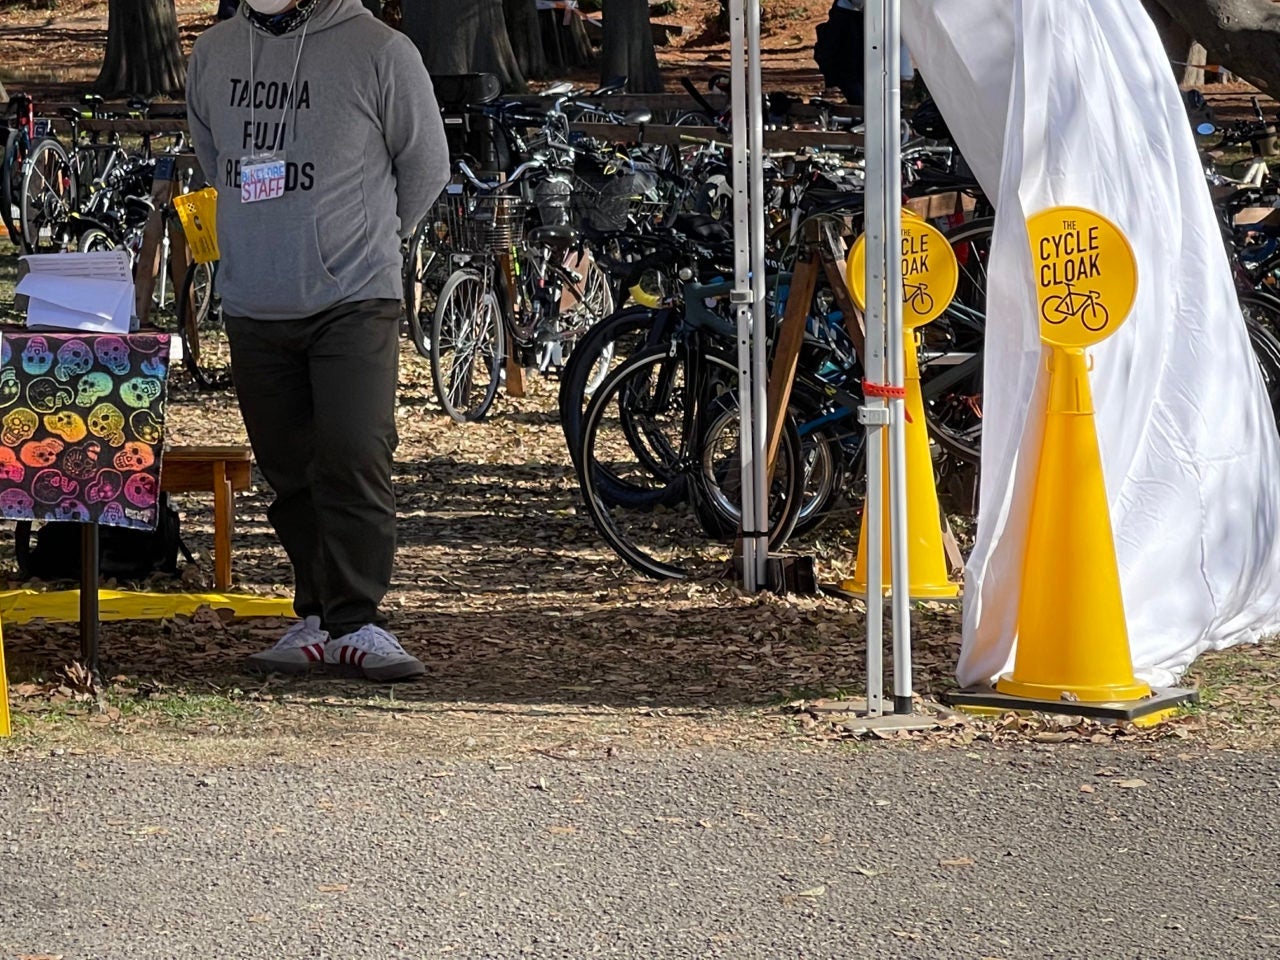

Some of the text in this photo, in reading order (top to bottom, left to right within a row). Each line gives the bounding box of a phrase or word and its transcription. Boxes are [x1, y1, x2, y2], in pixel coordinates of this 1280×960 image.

[229, 78, 310, 109] TACOMA
[243, 121, 286, 150] FUJI
[225, 158, 315, 191] REDS
[243, 177, 285, 201] STAFF
[1062, 220, 1076, 230] THE
[901, 234, 929, 256] CLE
[1039, 226, 1099, 261] CYCLE
[901, 254, 929, 276] OAK
[1040, 253, 1101, 288] CLOAK
